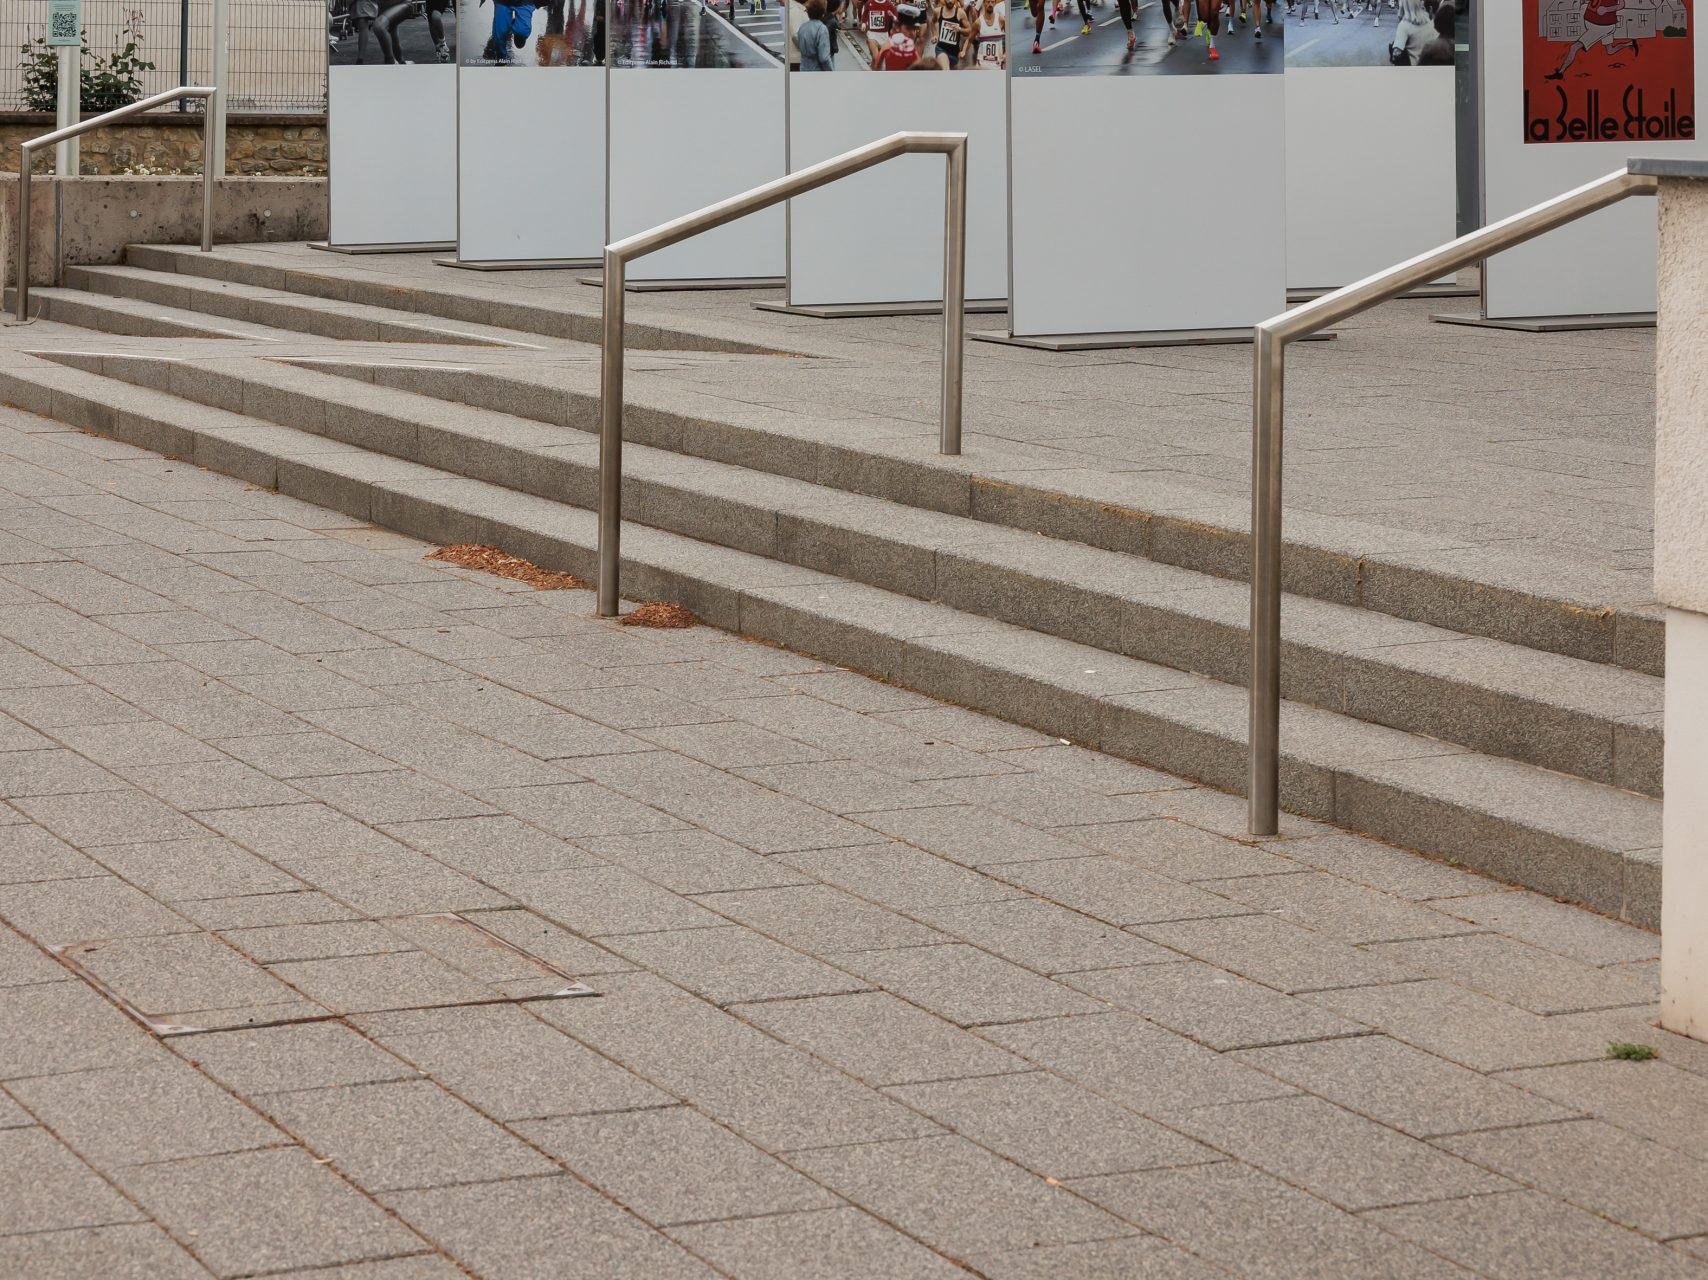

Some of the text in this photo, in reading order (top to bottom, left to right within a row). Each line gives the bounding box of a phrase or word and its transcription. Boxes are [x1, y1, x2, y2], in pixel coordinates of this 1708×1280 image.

[986, 43, 996, 56] 60
[1024, 65, 1043, 73] LASEL
[1524, 89, 1549, 141] la
